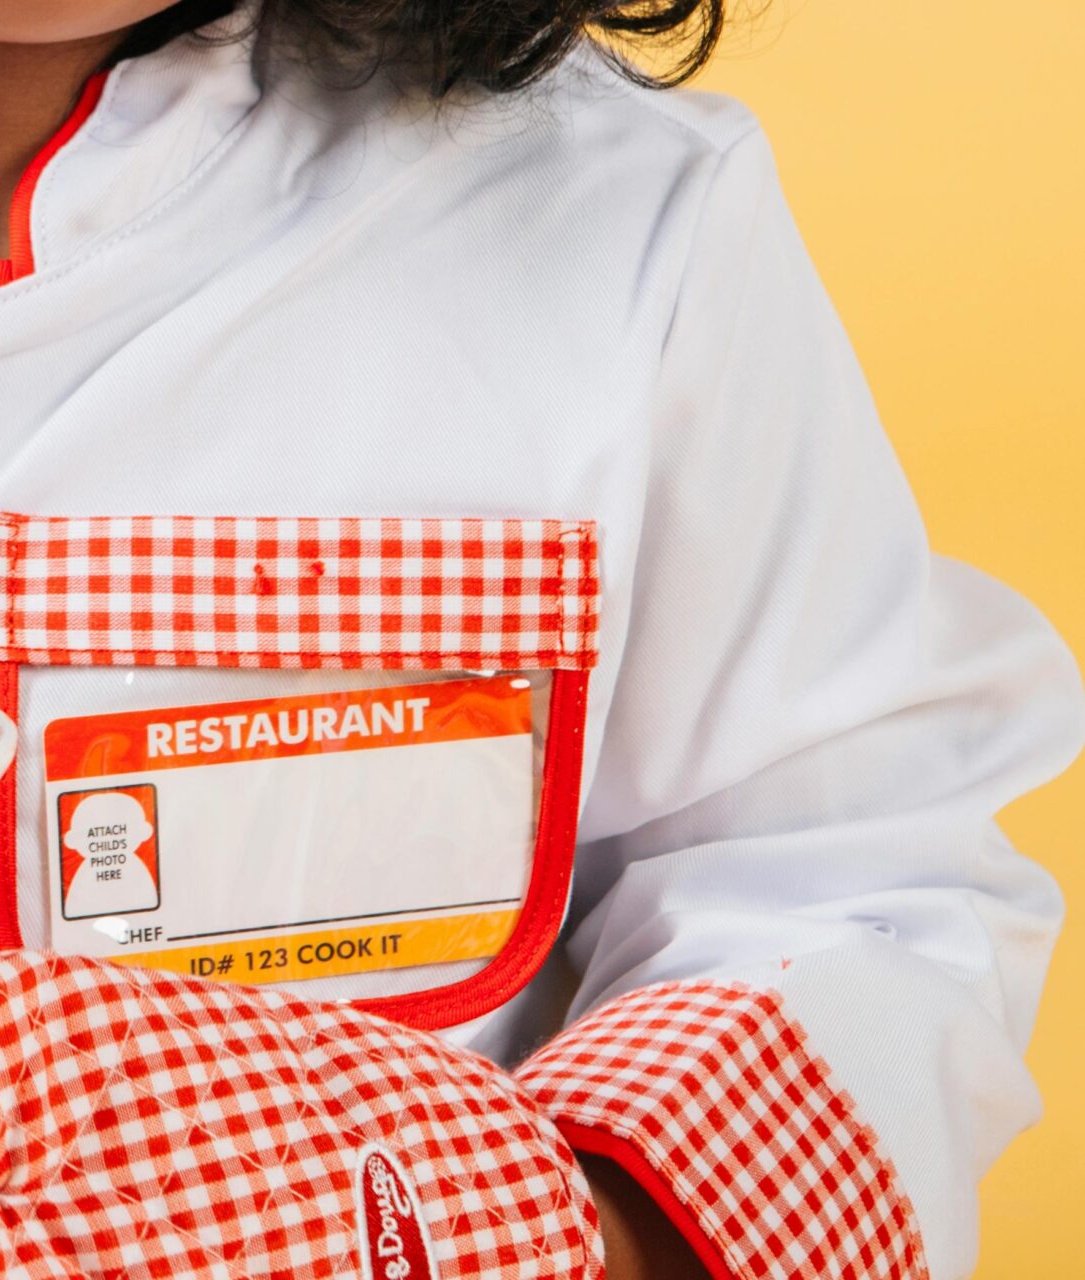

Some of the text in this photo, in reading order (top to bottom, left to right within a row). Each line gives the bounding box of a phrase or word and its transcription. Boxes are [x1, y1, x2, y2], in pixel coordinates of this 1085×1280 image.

[146, 697, 431, 759] RESTAURANT
[87, 824, 127, 838] ATTACH
[88, 838, 128, 853] CHILD'S
[90, 853, 127, 868] PHOTO
[96, 868, 122, 882] HERE
[190, 933, 403, 977] ID# 123 COOK IT
